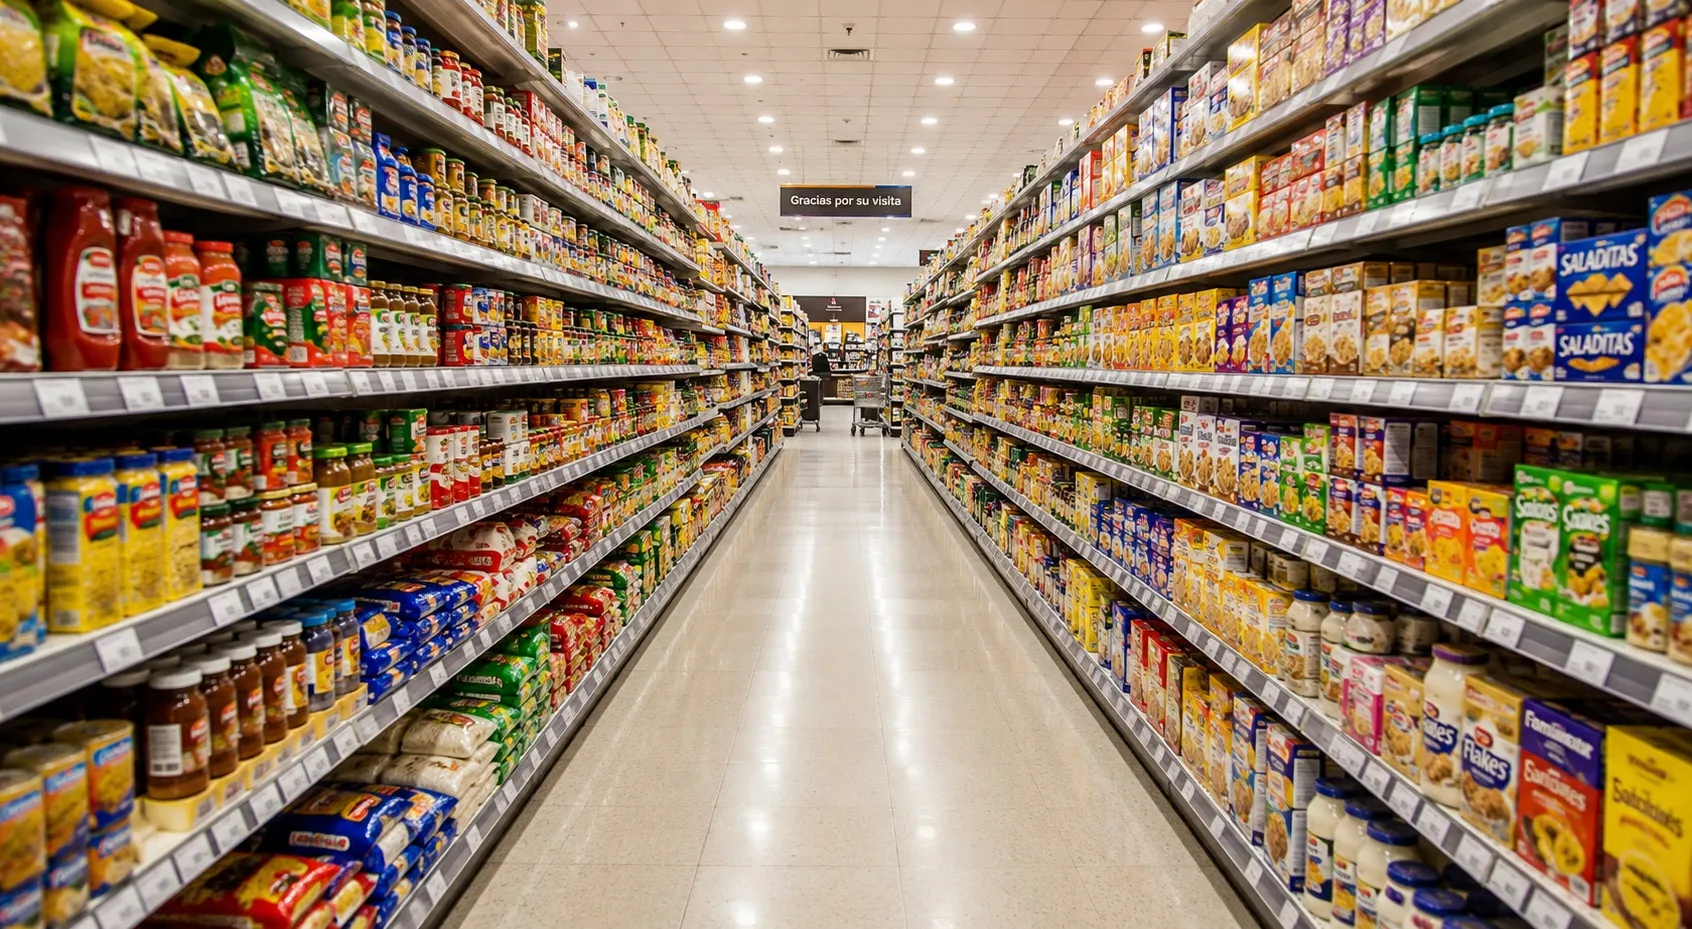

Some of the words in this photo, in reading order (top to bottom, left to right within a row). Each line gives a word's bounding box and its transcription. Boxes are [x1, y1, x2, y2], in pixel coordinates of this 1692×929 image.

[790, 195, 832, 206] Gracias
[834, 197, 854, 208] por
[856, 197, 869, 206] su
[872, 195, 902, 206] visita
[1559, 242, 1639, 277] SALADITAS
[1558, 331, 1635, 358] SALADITAS
[1463, 736, 1508, 781] Flakes
